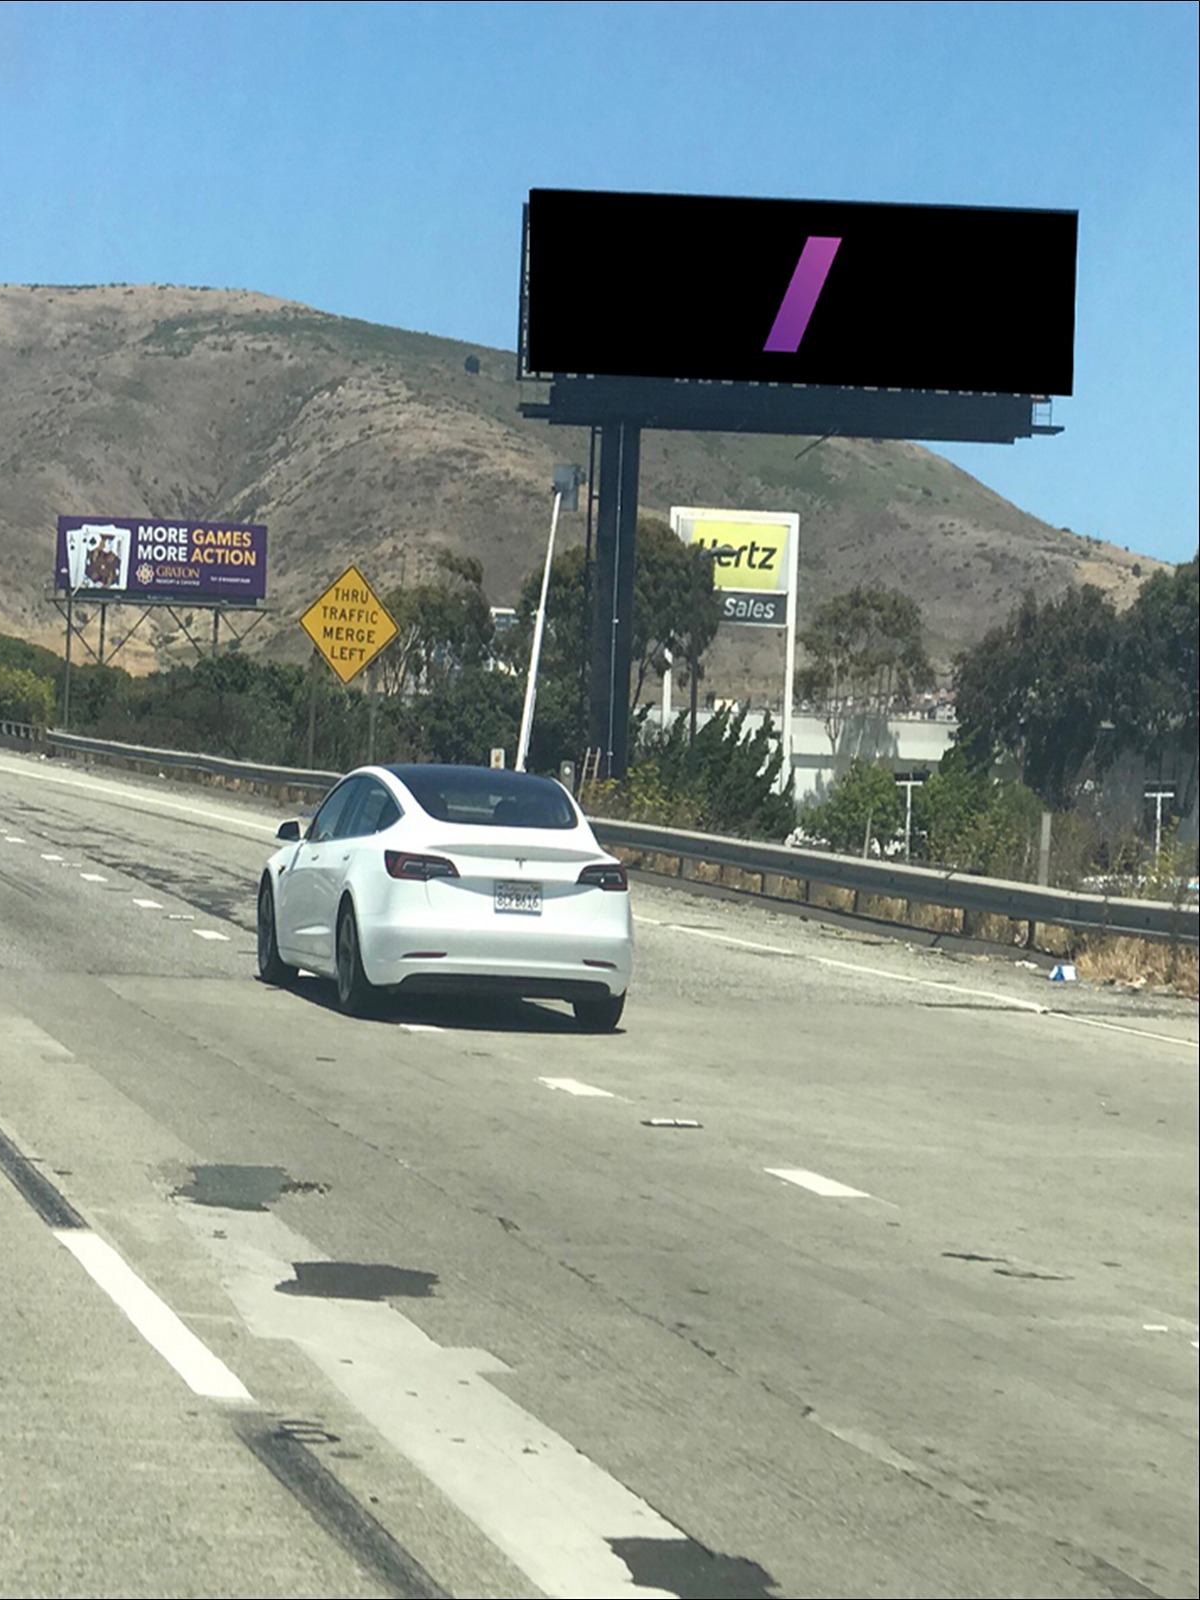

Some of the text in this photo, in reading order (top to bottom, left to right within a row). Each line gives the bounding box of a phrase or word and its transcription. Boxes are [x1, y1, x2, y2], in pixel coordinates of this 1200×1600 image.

[138, 526, 252, 548] MORE GAMES
[138, 544, 256, 566] MORE ACTION
[156, 565, 200, 578] GRATON
[334, 587, 369, 604] THRU
[322, 606, 379, 624] TRAFFIC
[723, 598, 776, 619] Sales
[323, 626, 375, 644] MERGE
[330, 646, 366, 661] LEFT
